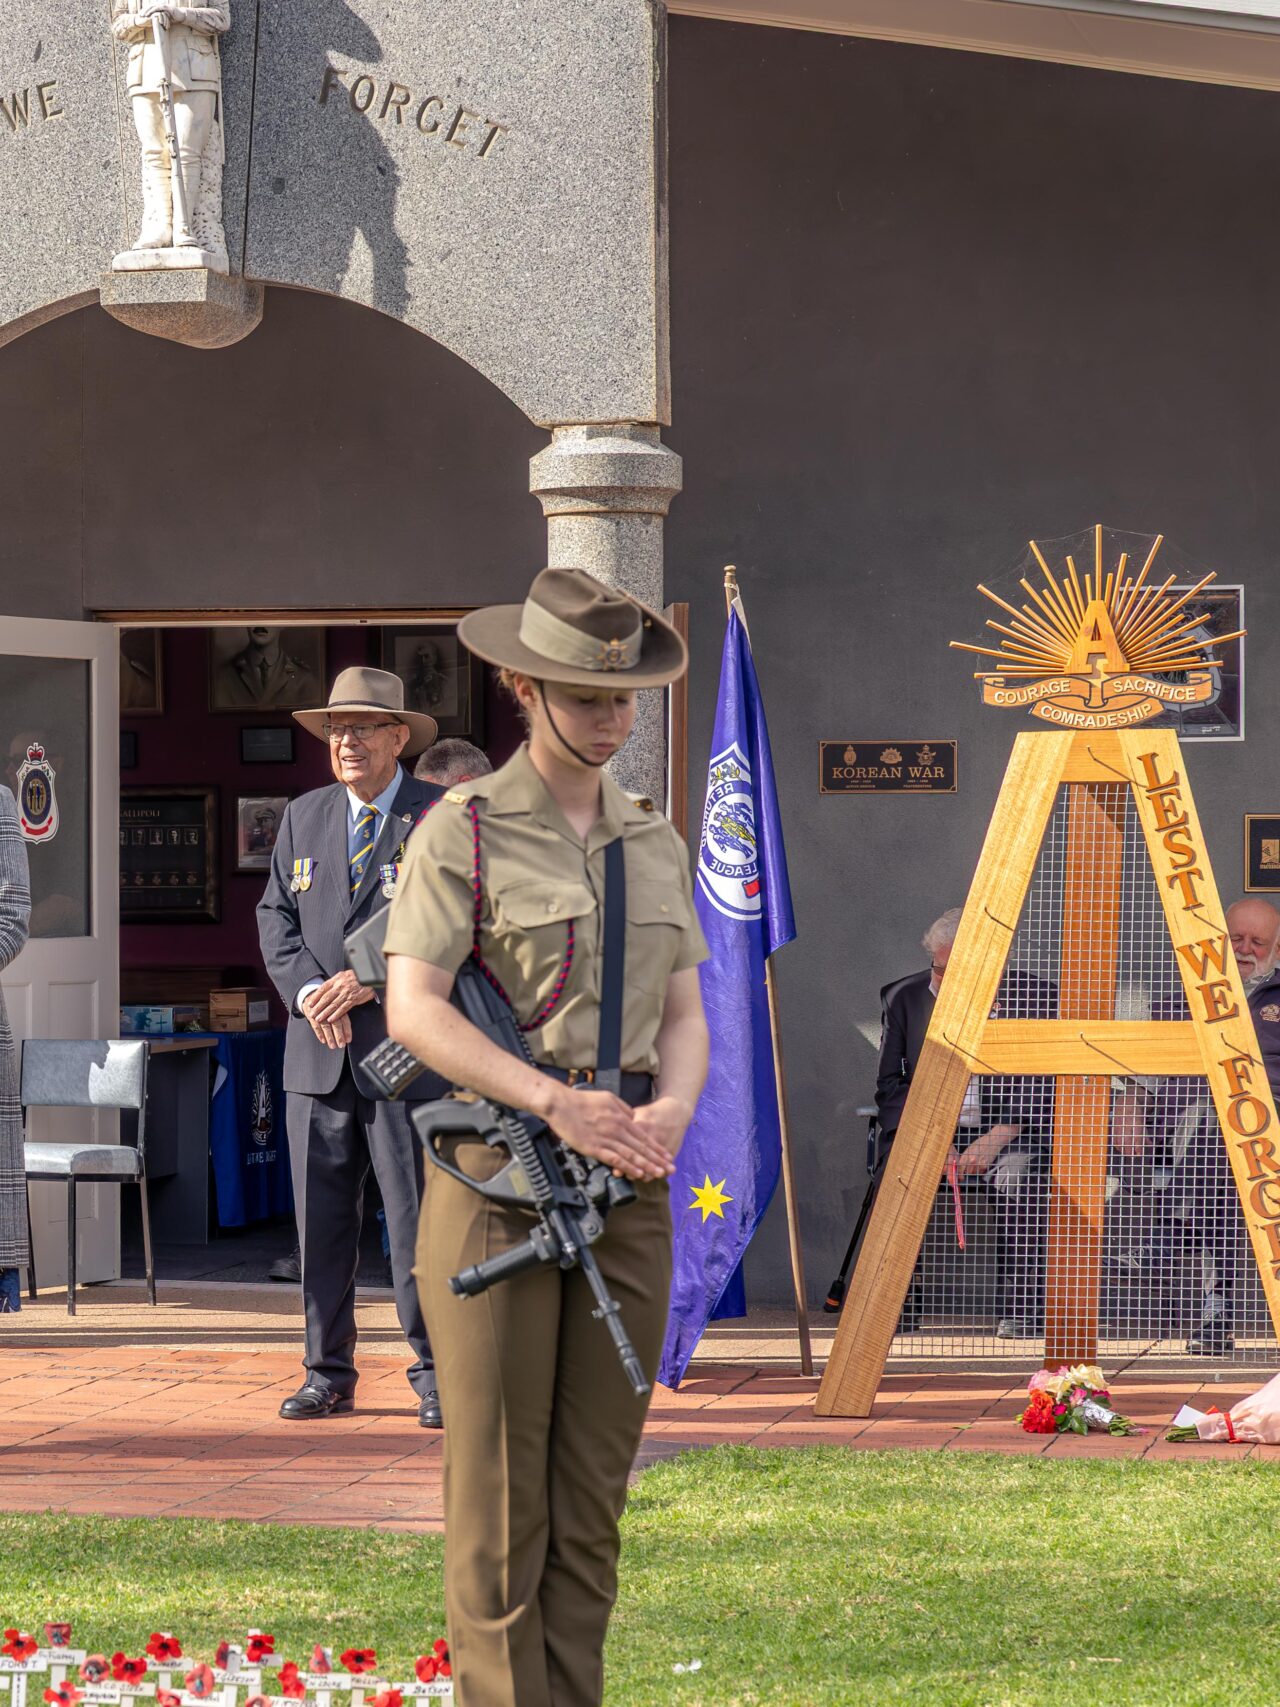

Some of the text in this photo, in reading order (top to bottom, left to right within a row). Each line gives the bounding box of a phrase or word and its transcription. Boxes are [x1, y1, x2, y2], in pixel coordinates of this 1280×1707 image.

[320, 67, 511, 160] FORGET
[994, 679, 1071, 705] COURAGE
[1113, 679, 1196, 701] SACRIFICE
[1040, 704, 1153, 729] COMRADESHIP
[832, 766, 945, 779] KOREAN WAR
[1137, 752, 1205, 911] LEST
[1176, 934, 1240, 1024] WE
